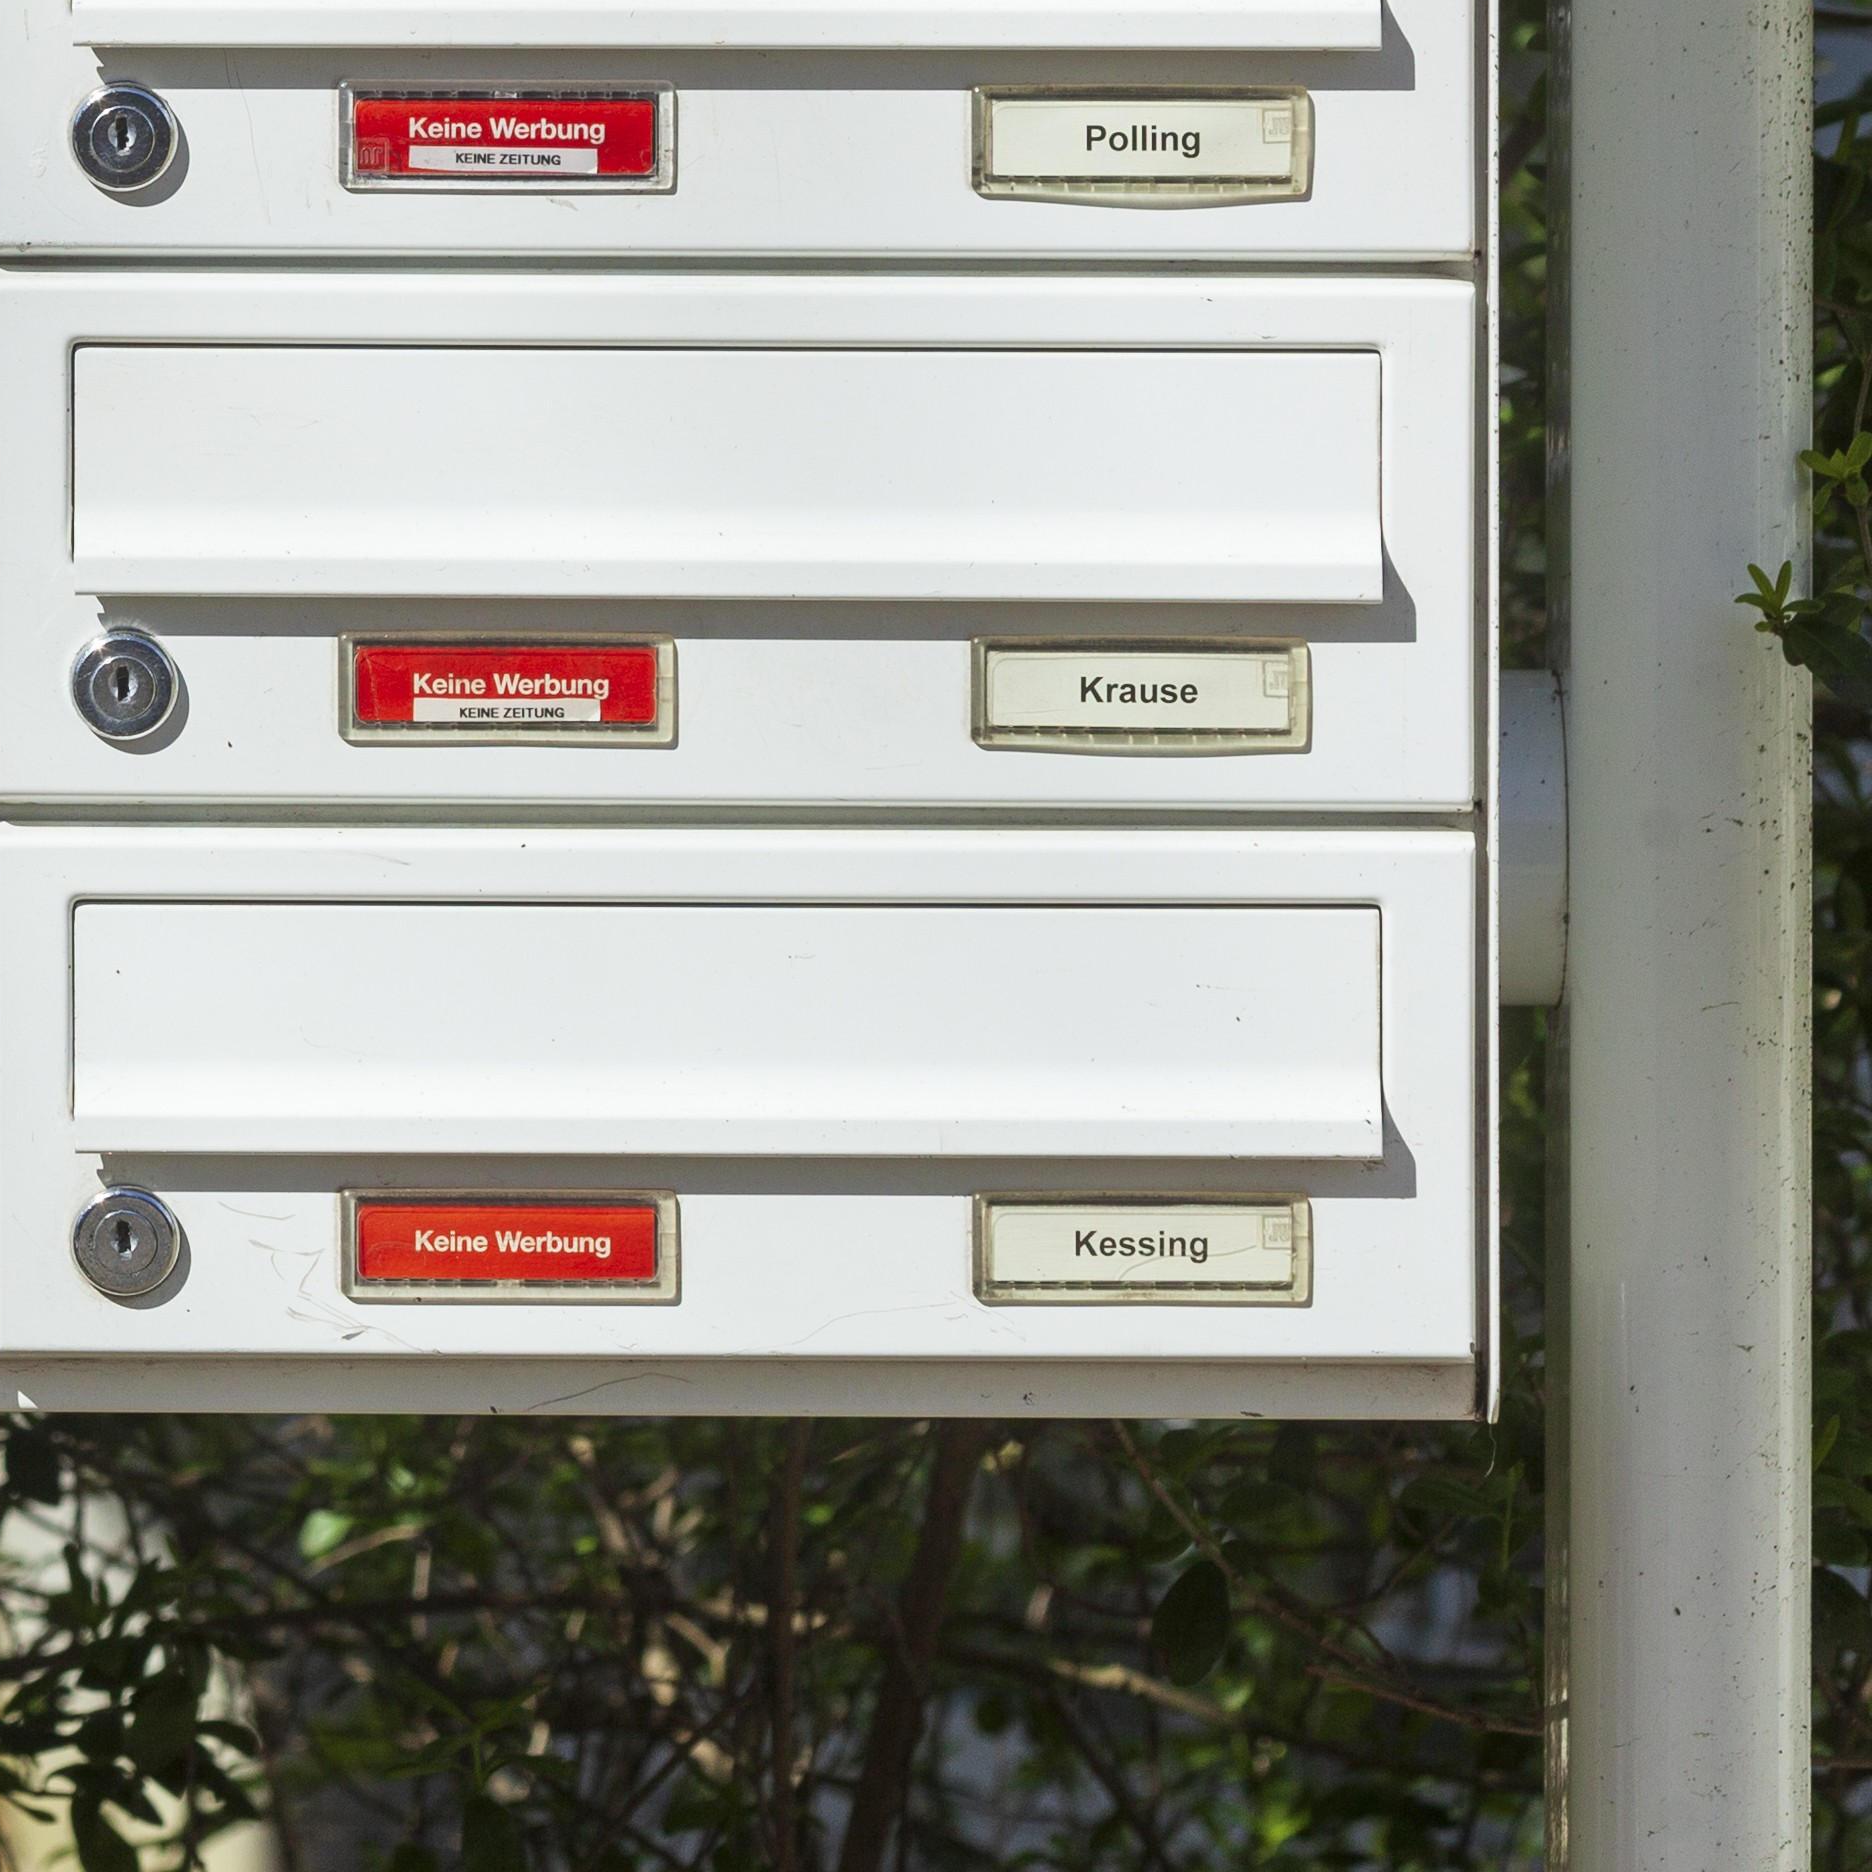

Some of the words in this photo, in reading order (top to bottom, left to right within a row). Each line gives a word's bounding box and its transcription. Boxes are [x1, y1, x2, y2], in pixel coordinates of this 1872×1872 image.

[409, 117, 482, 139] Keine
[490, 118, 605, 144] Werbung
[1086, 125, 1200, 159] Polling
[455, 153, 495, 164] KEINE
[499, 154, 561, 166] ZEITUNG
[413, 673, 485, 695] Keine
[493, 674, 609, 699] Werbung
[1080, 676, 1198, 704] Krause
[459, 708, 495, 719] KEINE
[503, 708, 565, 719] ZEITUNG
[415, 1230, 488, 1252] Keine
[495, 1231, 611, 1258] Werbung
[1075, 1230, 1208, 1264] Kessing
